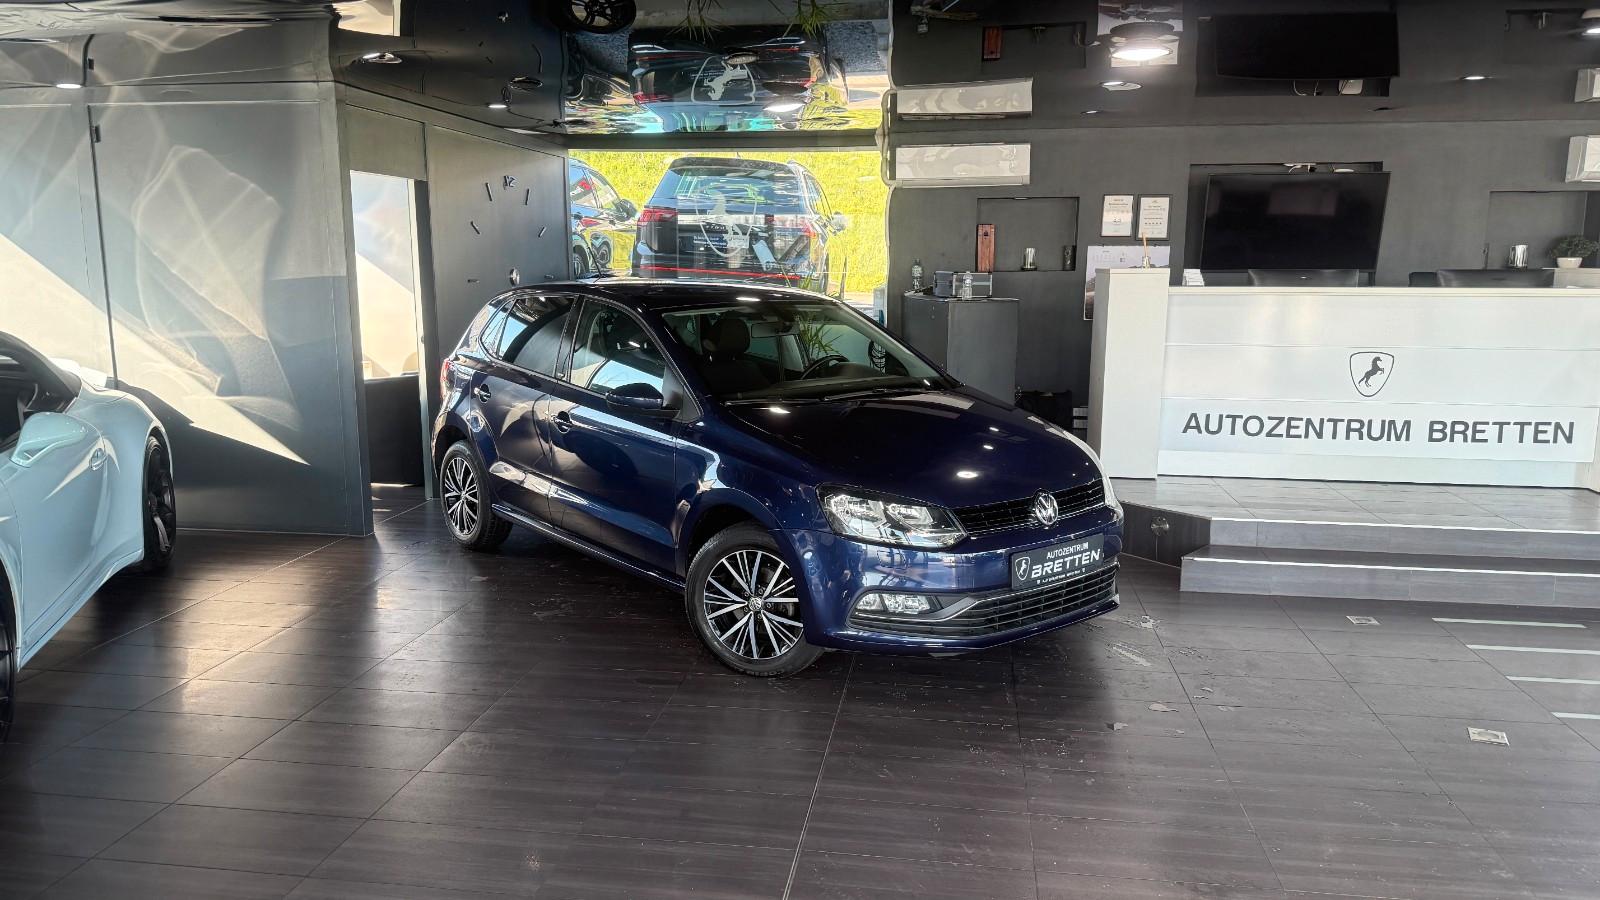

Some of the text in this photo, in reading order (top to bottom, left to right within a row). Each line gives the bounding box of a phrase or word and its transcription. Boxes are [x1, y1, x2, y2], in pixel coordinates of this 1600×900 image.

[1182, 412, 1574, 444] AUTOZENTRUM BRETTEN
[1031, 548, 1101, 579] BRETTEN
[1046, 541, 1089, 560] AUTOZENTRUM
